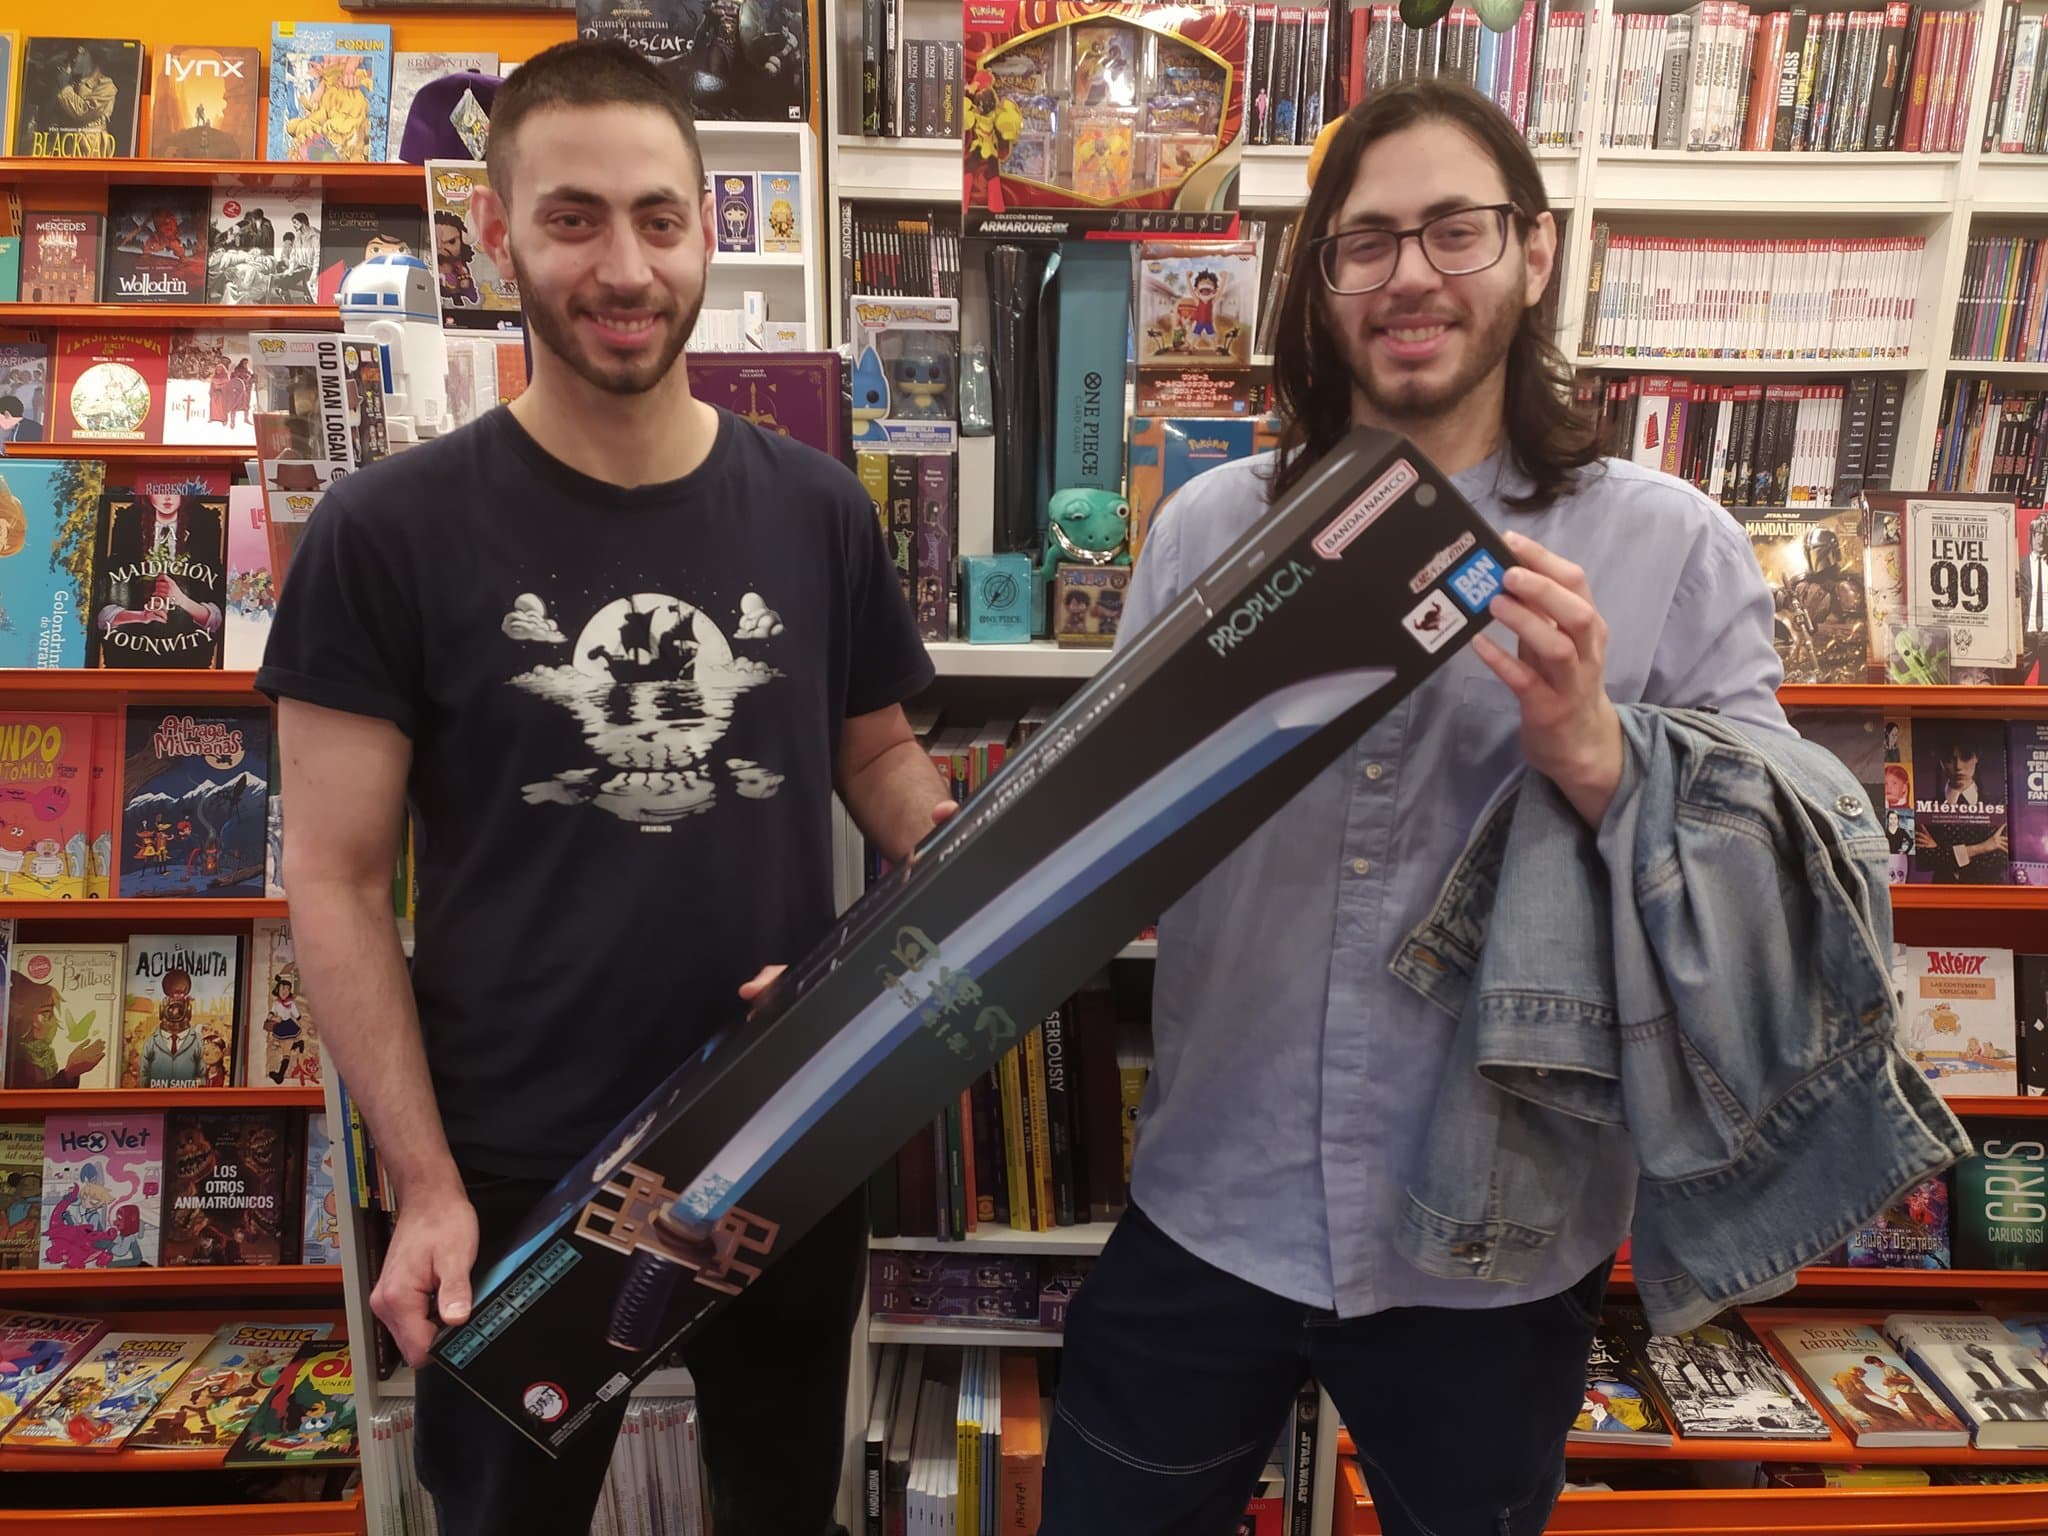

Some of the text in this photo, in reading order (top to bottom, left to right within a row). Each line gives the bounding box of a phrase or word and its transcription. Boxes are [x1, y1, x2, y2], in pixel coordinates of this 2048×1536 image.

[336, 39, 385, 51] FORUM
[164, 52, 245, 82] lynx
[407, 56, 482, 69] BRIGANTUS
[1778, 51, 1800, 108] KICK-ASS
[33, 131, 116, 157] BLACKSAD
[36, 222, 87, 232] MERCEDES
[842, 205, 853, 260] SERIOUSLY
[980, 220, 1053, 233] ARMAROUGE
[318, 341, 348, 462] OLD MAN LOGAN
[1666, 401, 1683, 441] Fantásticos
[1081, 425, 1101, 477] PIECE
[1323, 470, 1407, 551] BANDAI NAMCO
[154, 526, 177, 542] LA
[1932, 523, 1989, 540] FINAL FANTASY
[1932, 540, 1989, 562] LEVEL
[108, 559, 219, 591] MALDICIÓN
[1454, 555, 1496, 591] BAN
[1468, 575, 1501, 607] DAI
[1930, 561, 1990, 613] 99
[144, 595, 176, 612] DE
[1207, 559, 1311, 658] PROPLICA
[103, 622, 215, 656] YOUNWITY
[184, 715, 228, 744] fraga
[1916, 799, 2005, 815] Miércoles
[1927, 951, 1987, 975] Astérix
[1045, 1010, 1065, 1093] SERIOUSLY
[150, 1079, 168, 1089] DAN
[60, 1127, 151, 1154] Hex Vet
[213, 1165, 238, 1179] LOS
[1983, 1139, 2047, 1223] GRIS
[205, 1180, 246, 1194] OTROS
[174, 1194, 275, 1210] ANIMATRÓNICOS
[1855, 1232, 1889, 1250] BRUJAS
[1988, 1226, 2044, 1244] CARLOS SISÍ
[3, 1315, 94, 1339] SONIC
[237, 1326, 317, 1342] SONIC
[1804, 1326, 1826, 1340] Yo
[1845, 1327, 1857, 1338] ti
[120, 1340, 185, 1354] SONIC
[1800, 1336, 1878, 1352] tampoco
[1298, 1466, 1311, 1505] WARS
